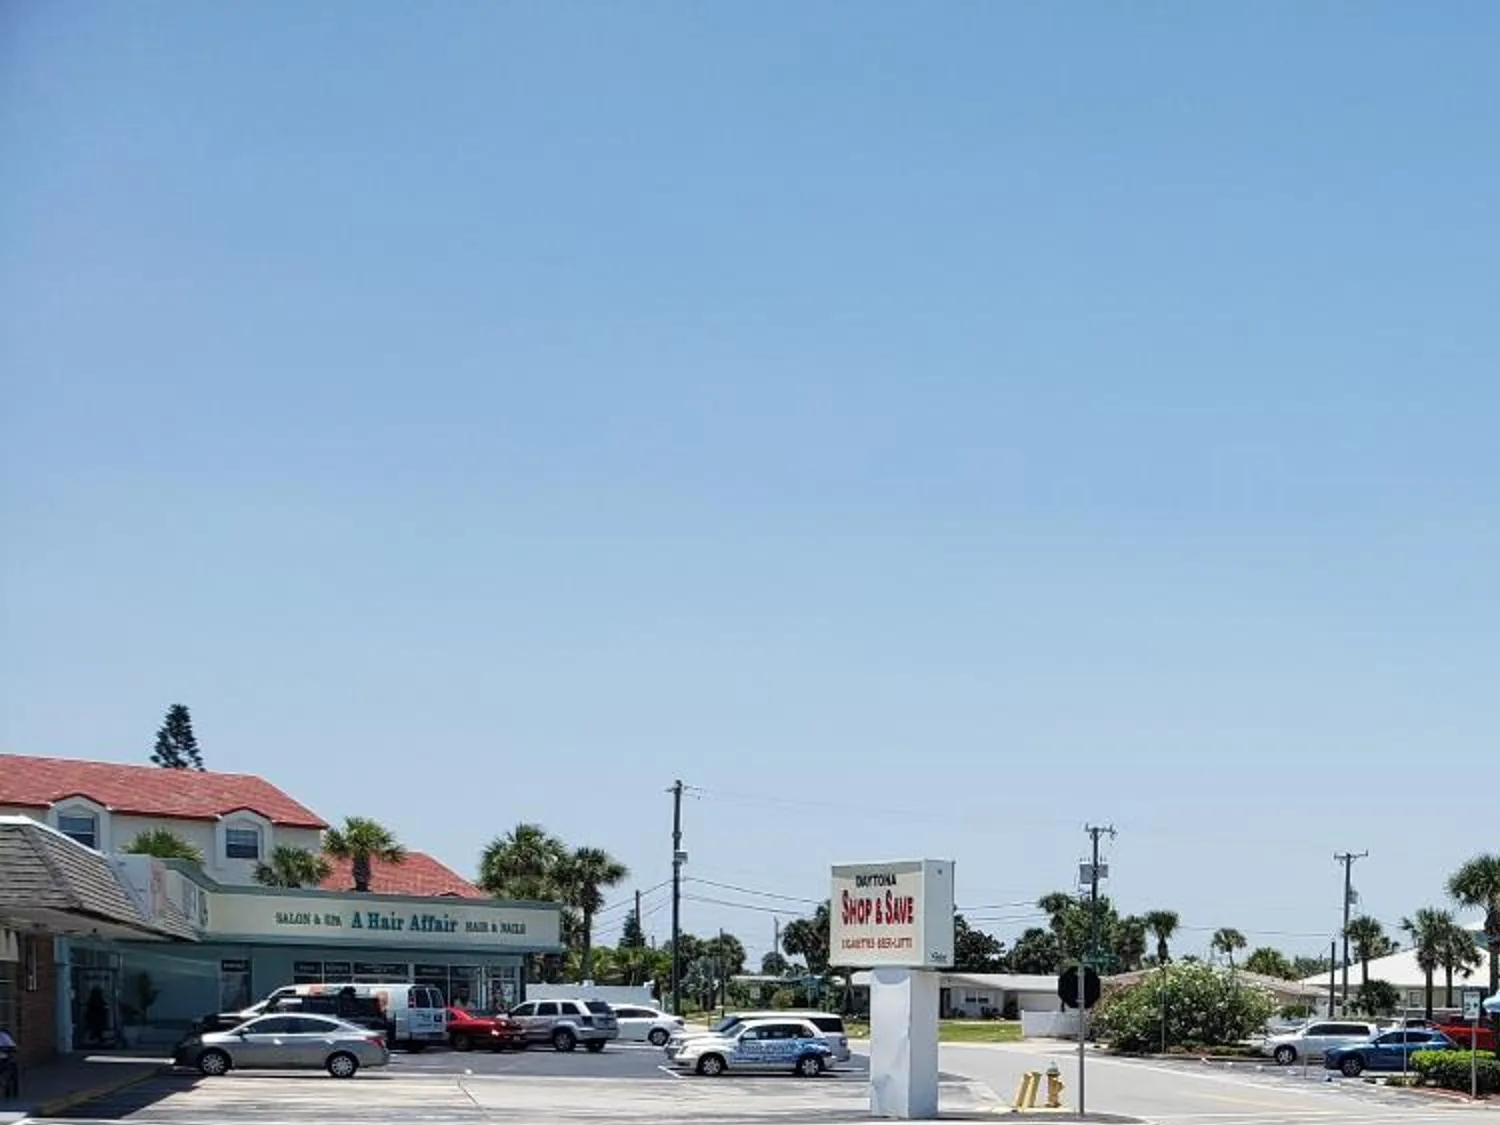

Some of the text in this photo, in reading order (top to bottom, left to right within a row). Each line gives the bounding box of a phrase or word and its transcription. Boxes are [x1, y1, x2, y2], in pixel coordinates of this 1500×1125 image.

[855, 873, 897, 888] DAYTONA
[275, 912, 311, 925] SALON
[351, 911, 363, 929] A
[367, 911, 405, 931] Hair
[409, 913, 458, 932] Affair
